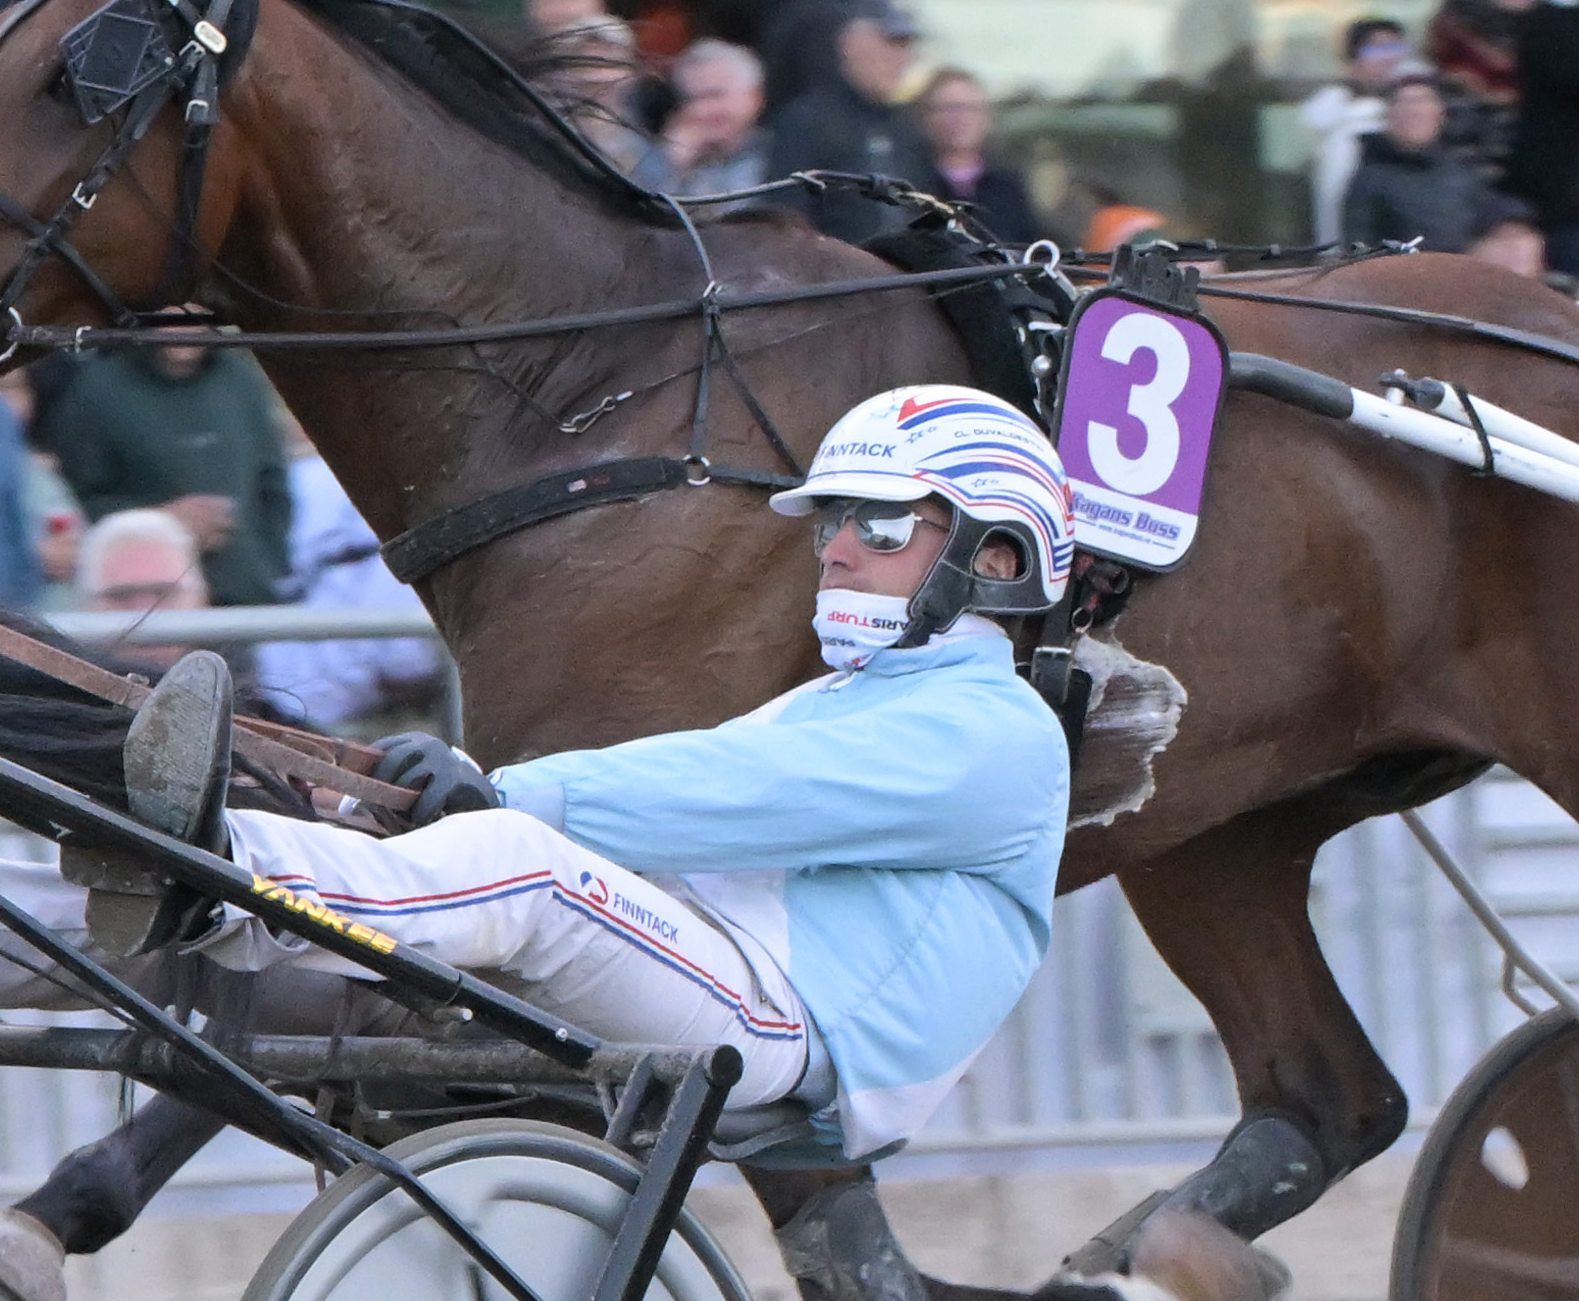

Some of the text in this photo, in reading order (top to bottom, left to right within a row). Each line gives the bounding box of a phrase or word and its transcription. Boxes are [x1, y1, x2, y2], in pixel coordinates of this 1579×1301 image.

[1087, 312, 1190, 495] 3
[1133, 511, 1181, 541] Buss
[828, 610, 909, 631] ARISTURF
[251, 873, 398, 955] YANKEE
[613, 892, 678, 945] FINNTACK
